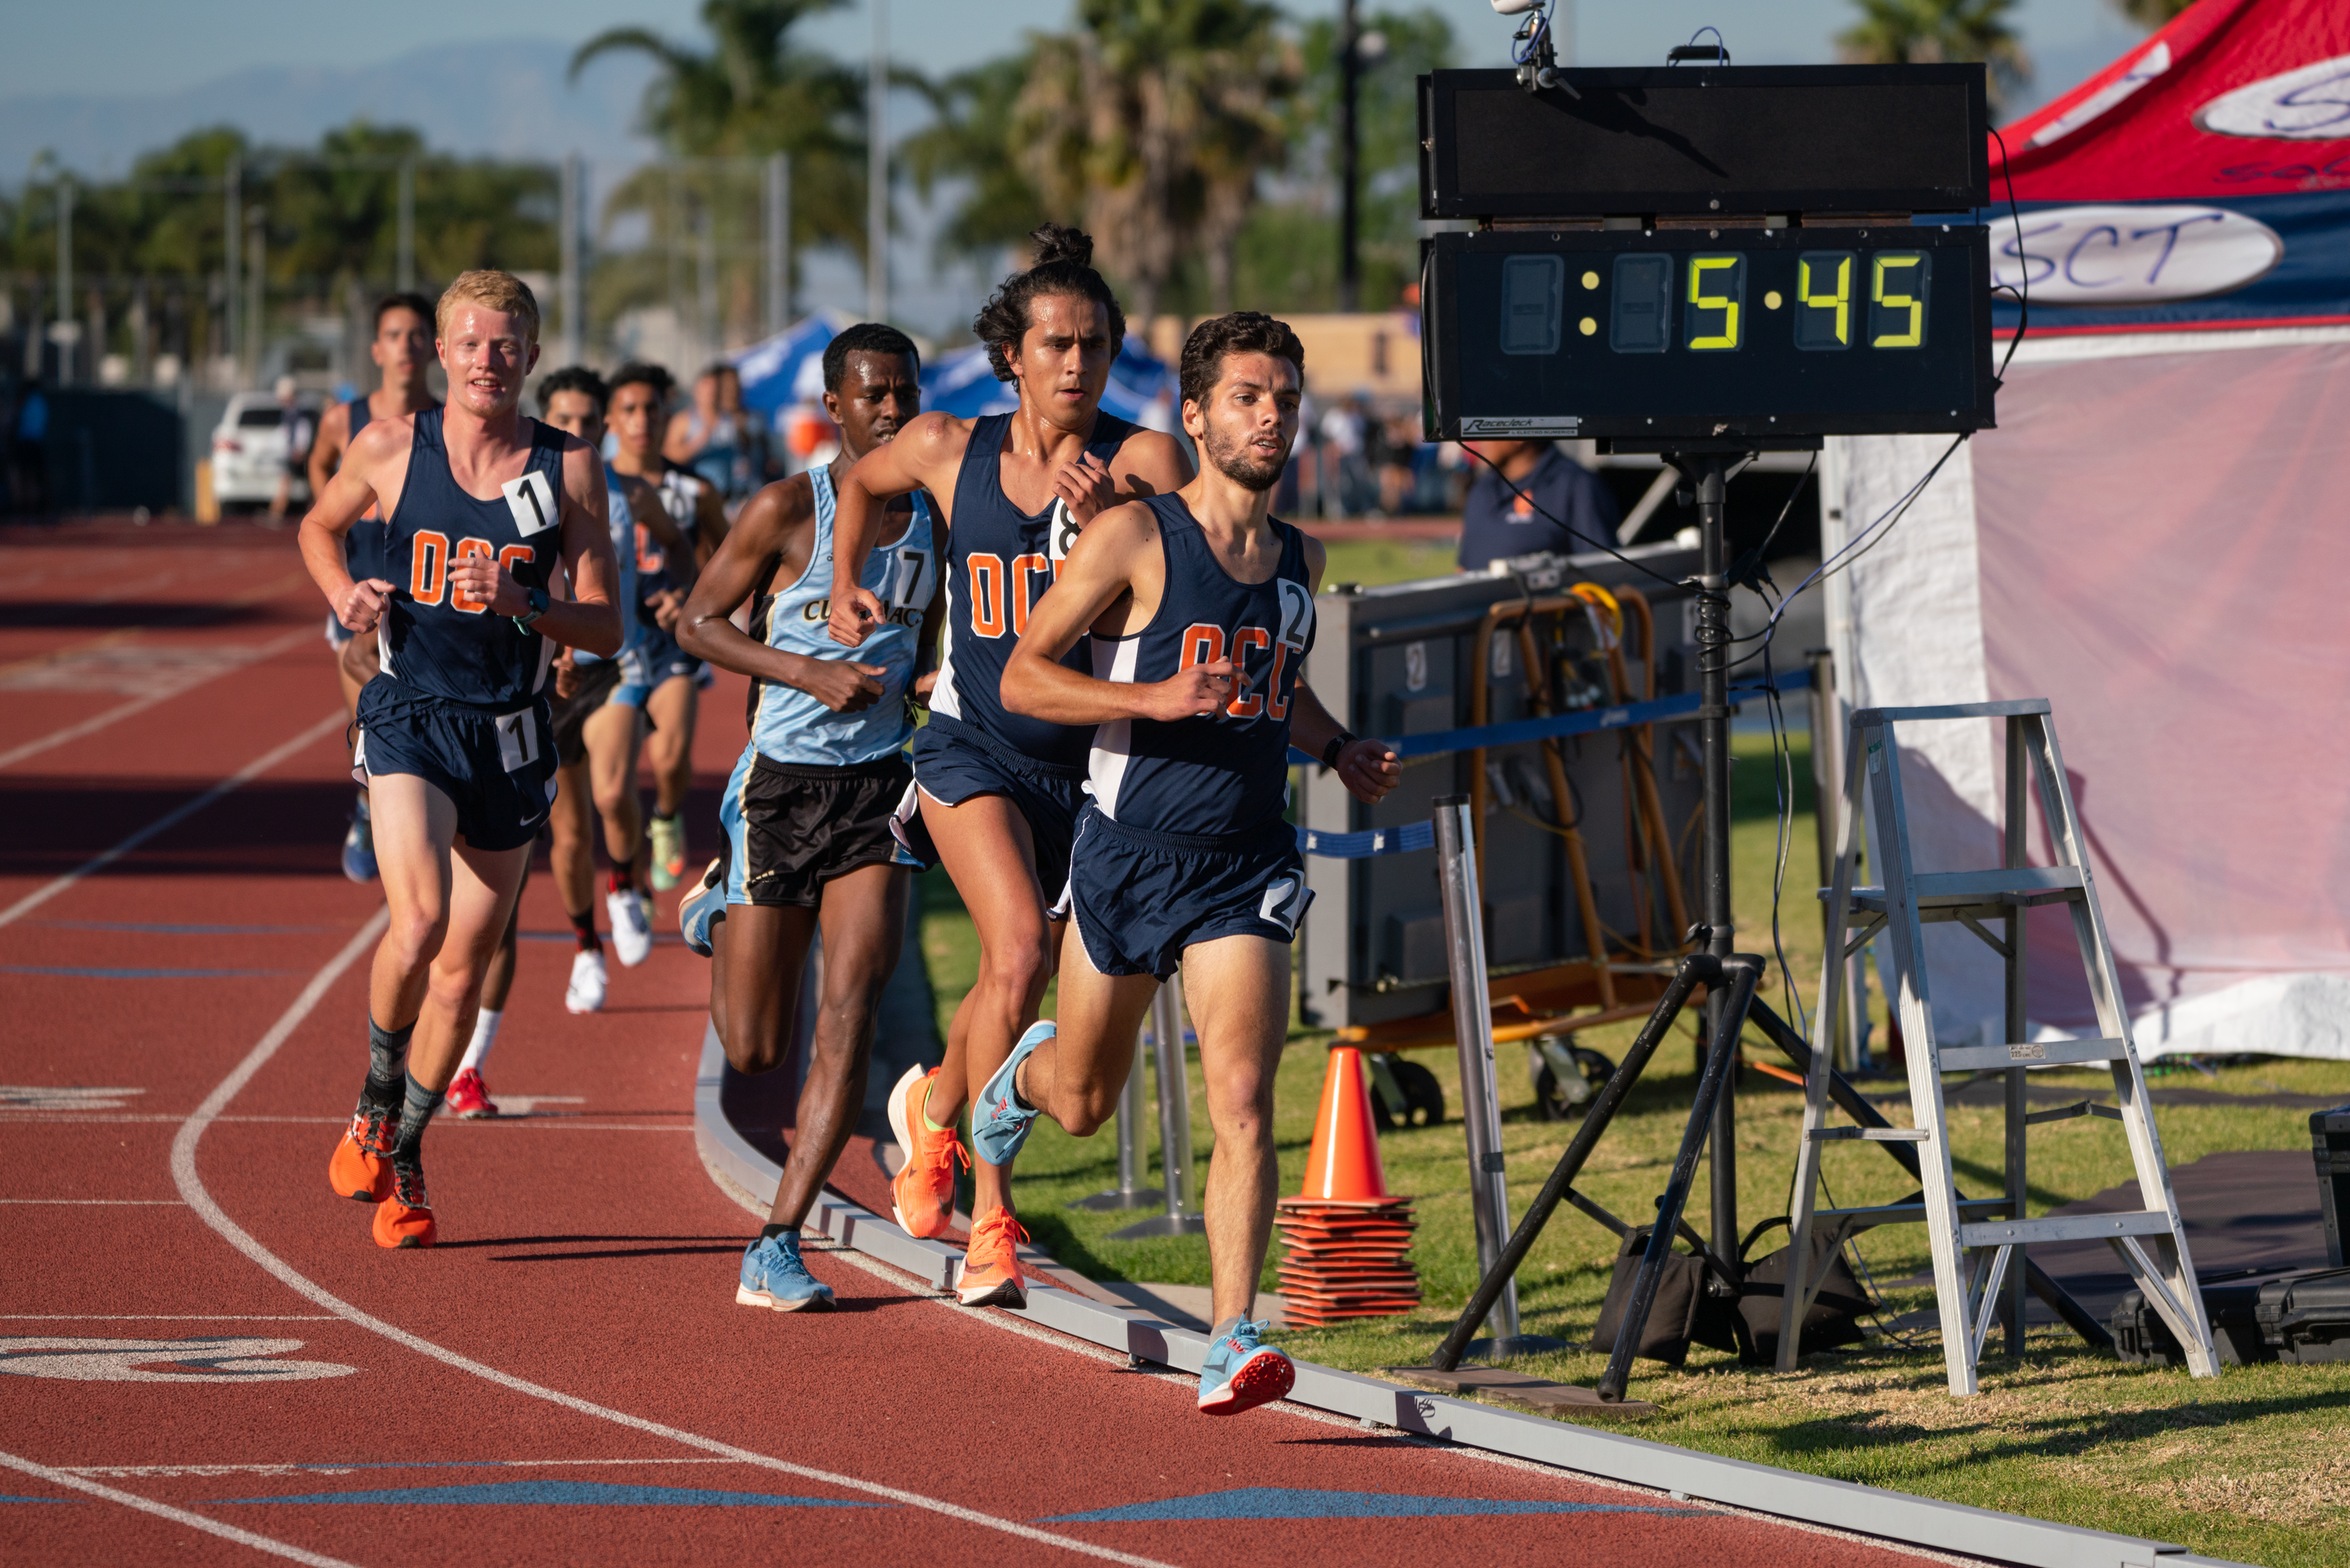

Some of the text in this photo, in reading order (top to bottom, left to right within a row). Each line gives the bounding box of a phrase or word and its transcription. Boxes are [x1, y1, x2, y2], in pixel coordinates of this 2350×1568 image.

[1994, 211, 2224, 288] SCT
[516, 478, 547, 528] 1
[903, 551, 925, 605] 7
[1285, 584, 1305, 646] 2
[506, 713, 530, 763] 1
[1269, 870, 1300, 930] 2
